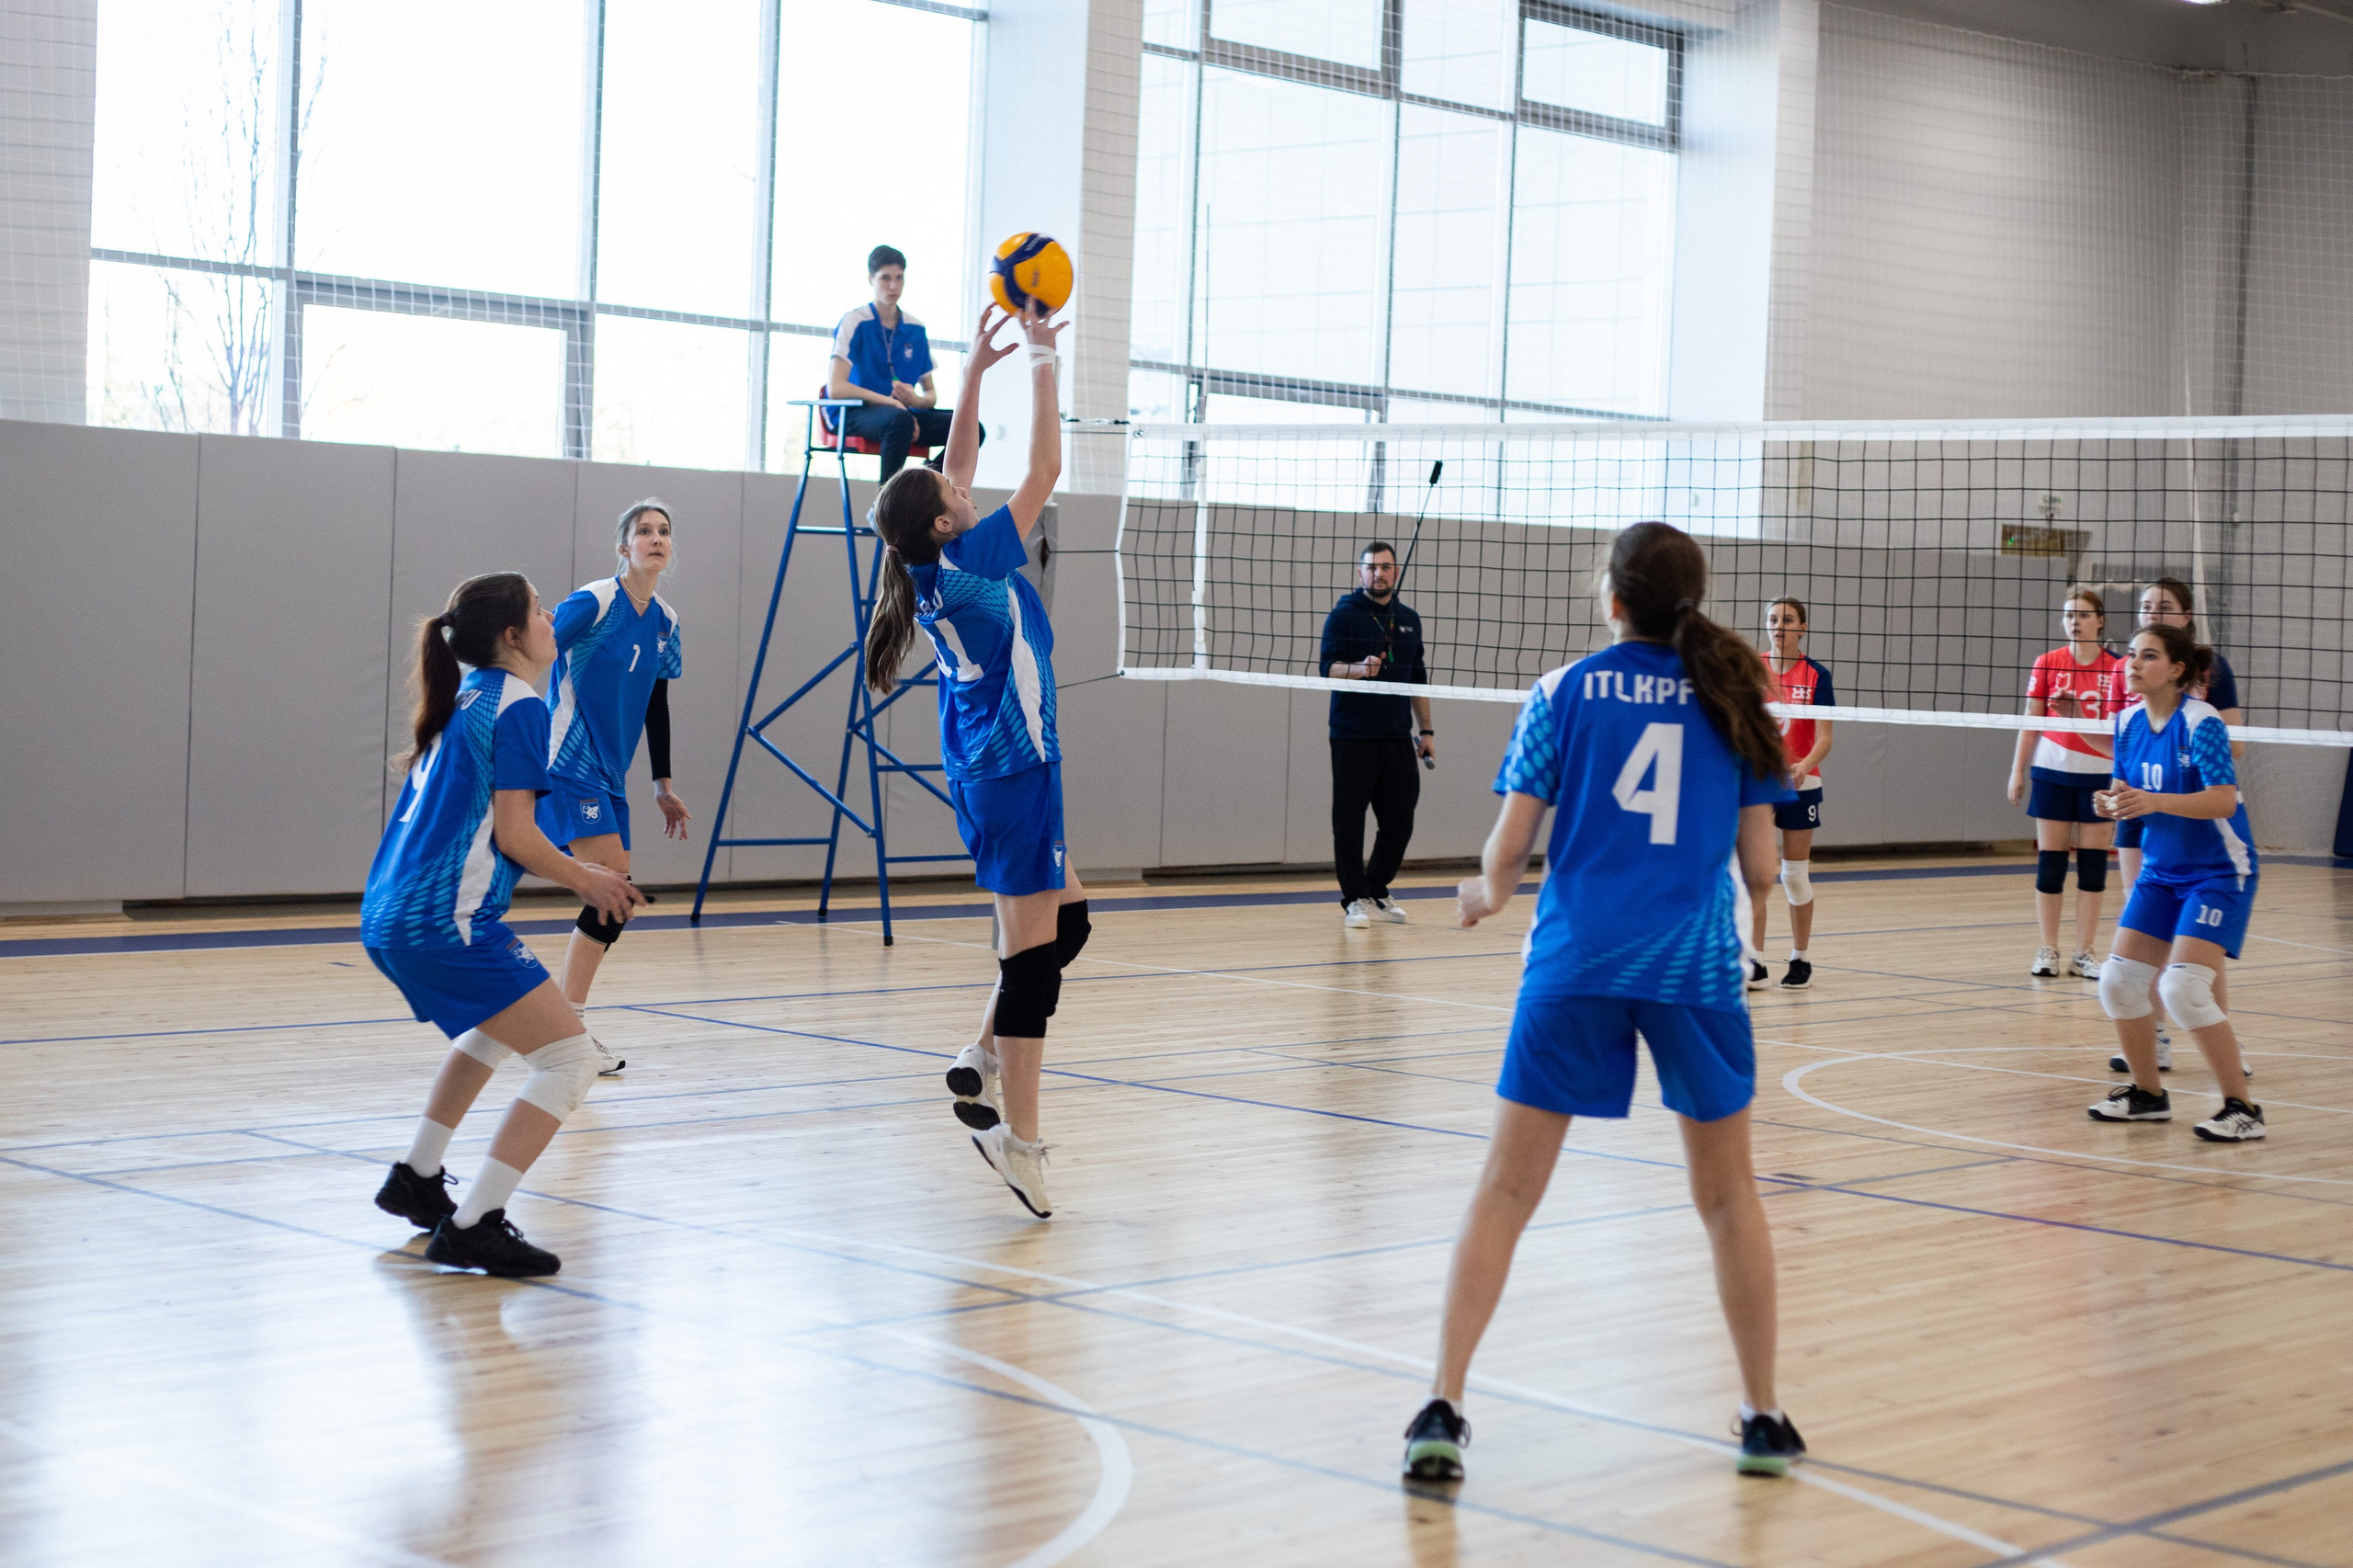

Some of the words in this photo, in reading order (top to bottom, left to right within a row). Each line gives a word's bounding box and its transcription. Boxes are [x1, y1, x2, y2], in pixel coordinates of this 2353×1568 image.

[1612, 722, 1684, 846] 4
[2141, 761, 2163, 791] 10
[1807, 804, 1817, 822] 9
[2195, 904, 2223, 927] 10
